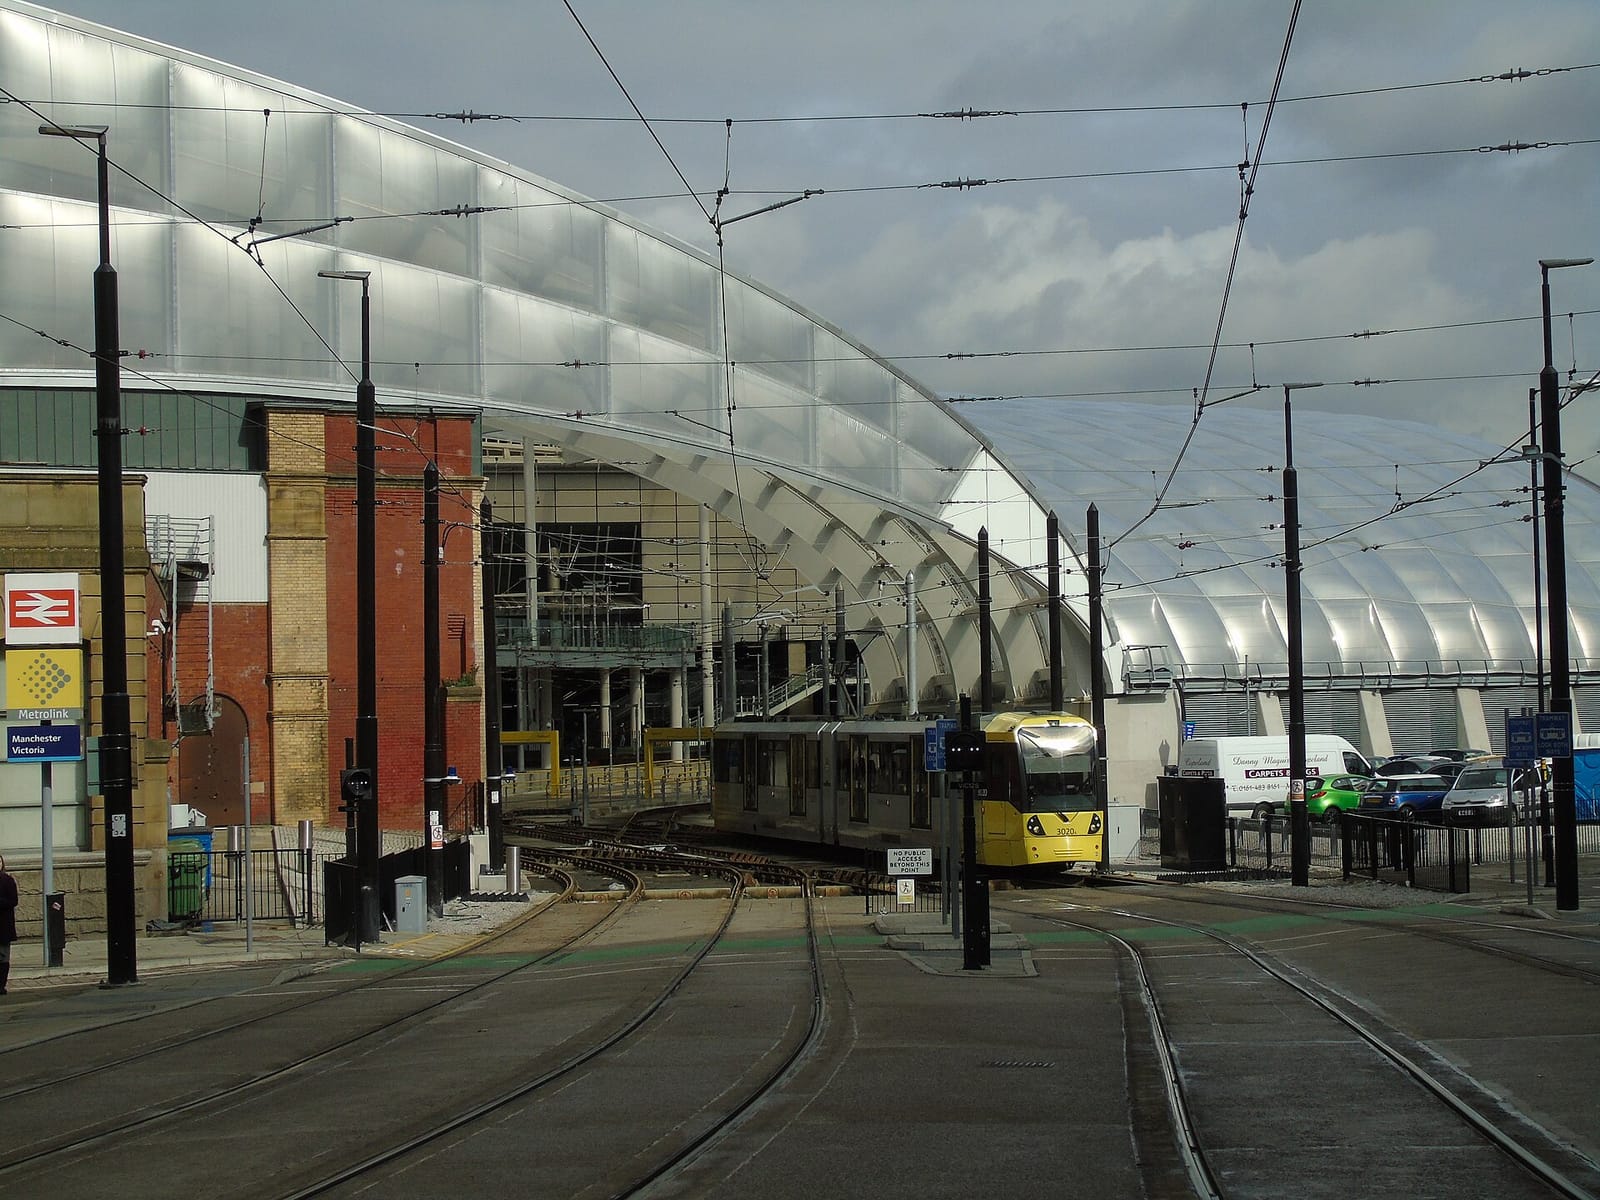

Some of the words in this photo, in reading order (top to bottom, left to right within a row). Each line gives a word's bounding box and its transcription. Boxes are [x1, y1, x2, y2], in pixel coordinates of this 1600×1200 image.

[18, 709, 69, 719] Metrolink
[12, 735, 62, 743] Manchester
[12, 746, 45, 754] Victoria
[1232, 757, 1258, 766] Danny
[1248, 770, 1284, 778] CARPETS
